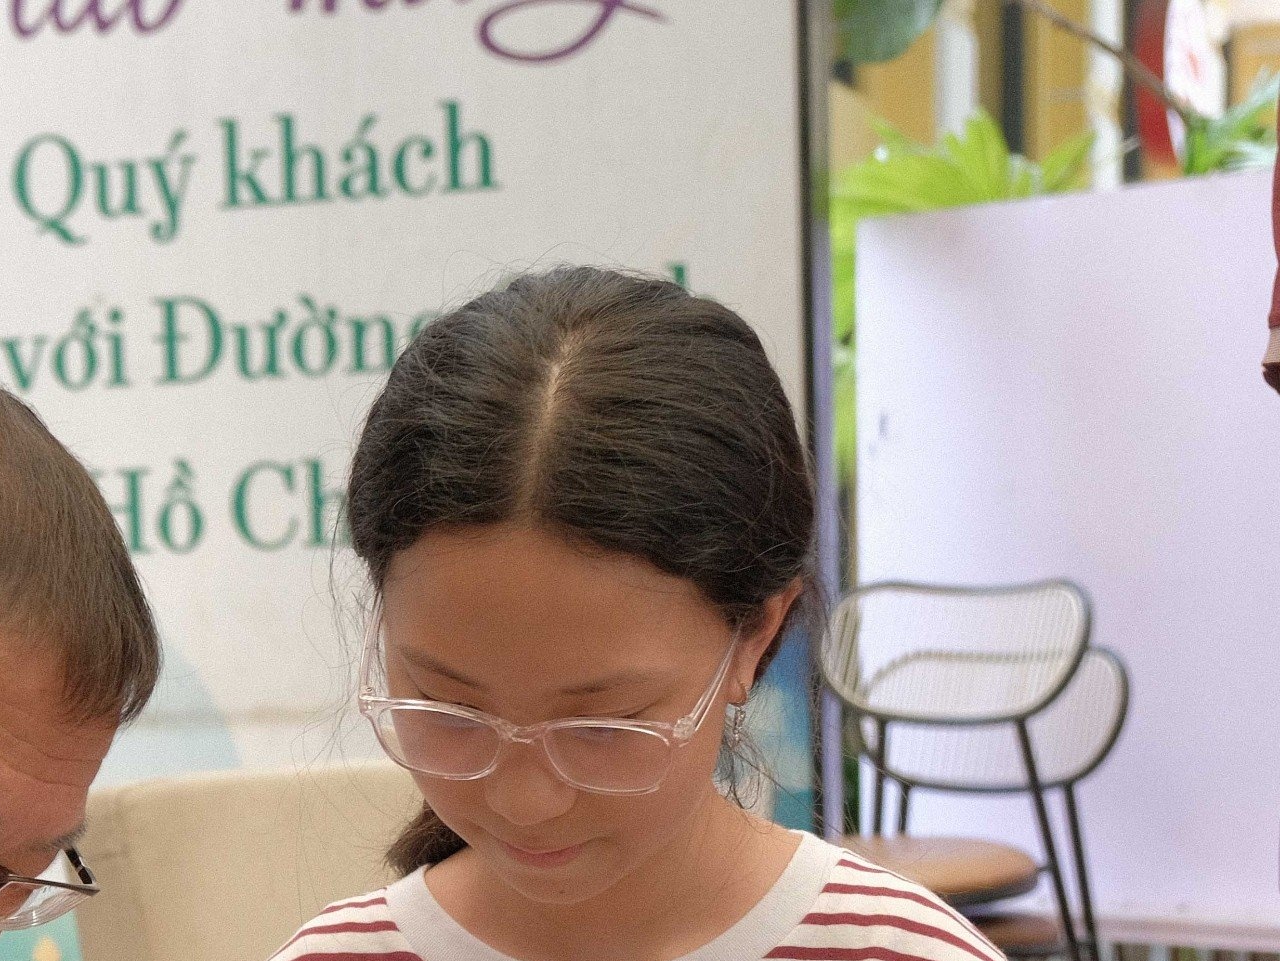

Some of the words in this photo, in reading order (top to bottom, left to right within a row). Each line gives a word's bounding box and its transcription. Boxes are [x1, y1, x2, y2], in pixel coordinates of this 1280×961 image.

[11, 129, 194, 244] Quý
[219, 100, 502, 209] khách
[229, 455, 355, 551] Ch
